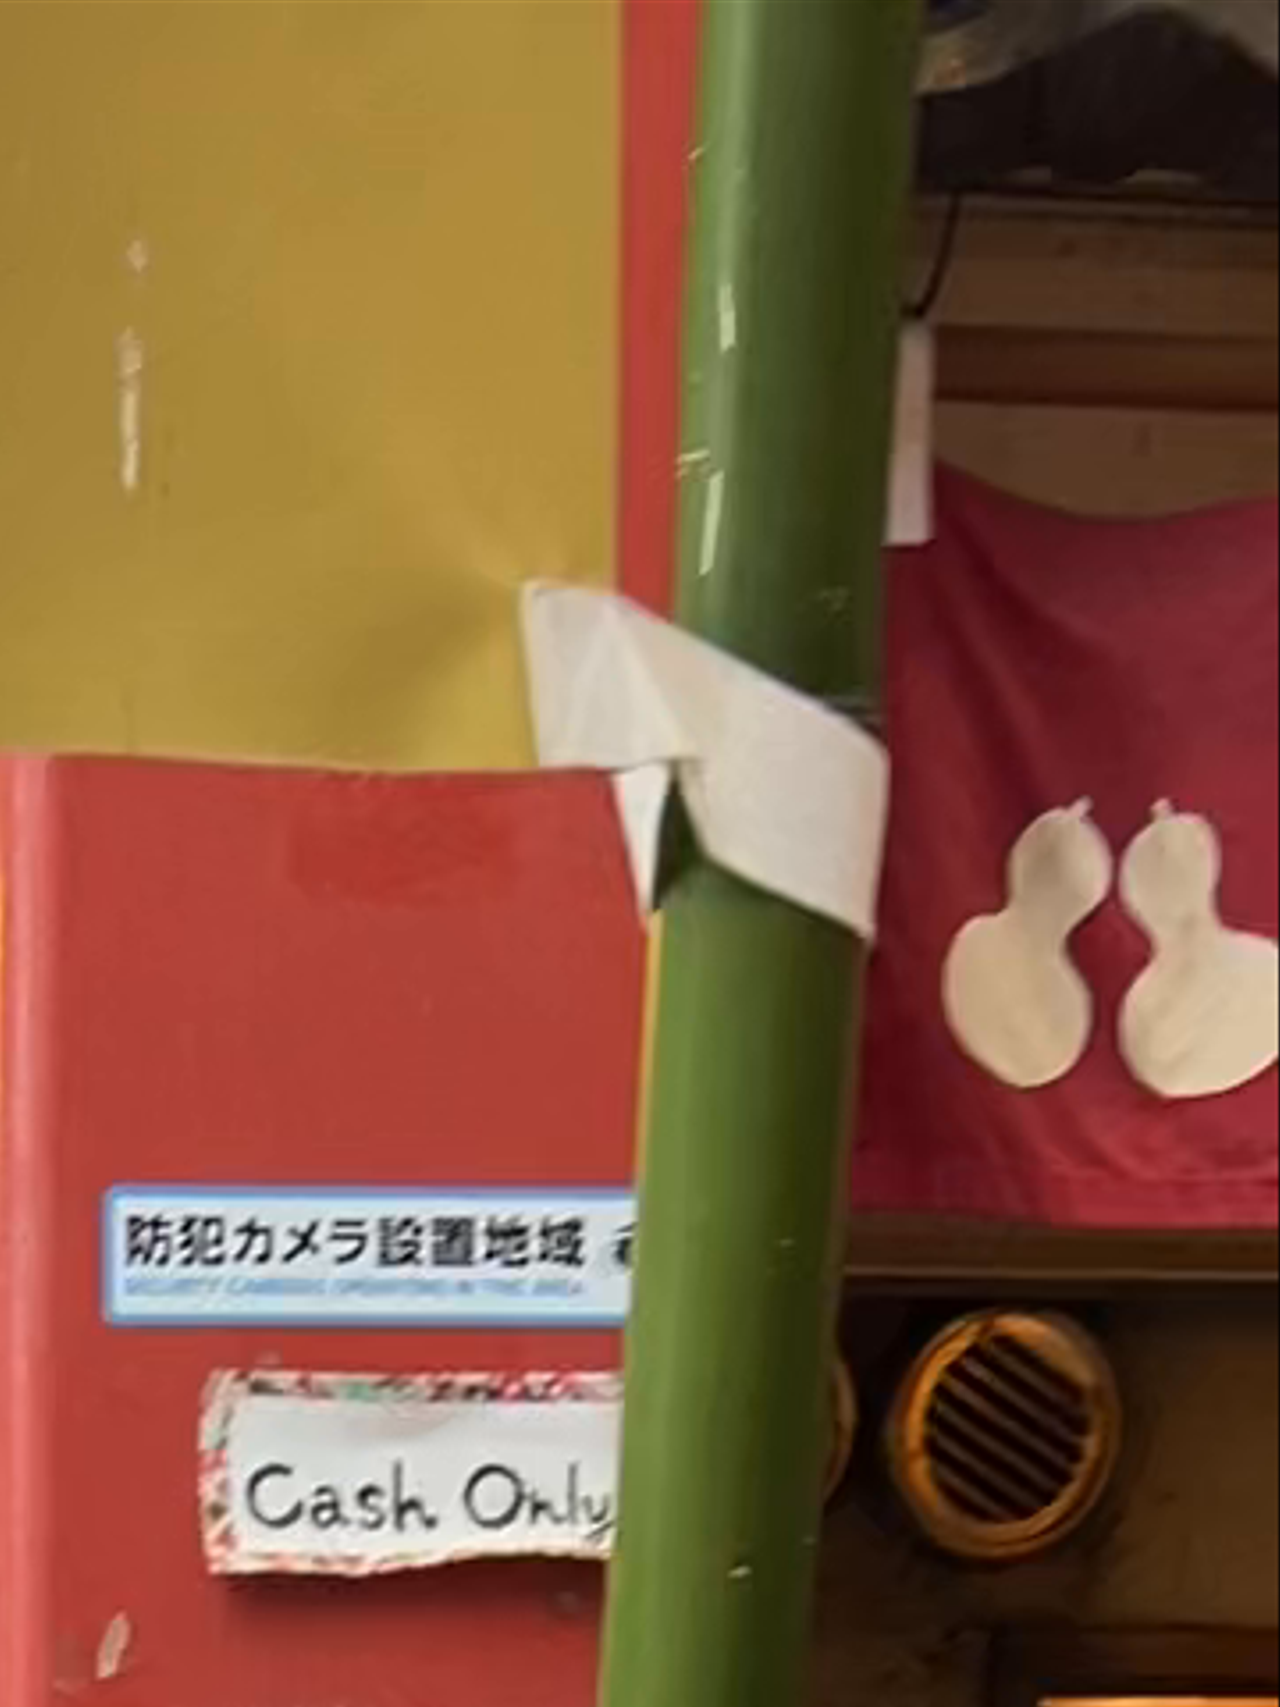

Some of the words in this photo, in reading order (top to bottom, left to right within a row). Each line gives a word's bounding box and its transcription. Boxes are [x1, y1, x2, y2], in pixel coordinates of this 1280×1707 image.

[126, 1216, 586, 1267] 防犯カメラ設置地域
[246, 1458, 438, 1532] Cash
[464, 1460, 615, 1541] Only
